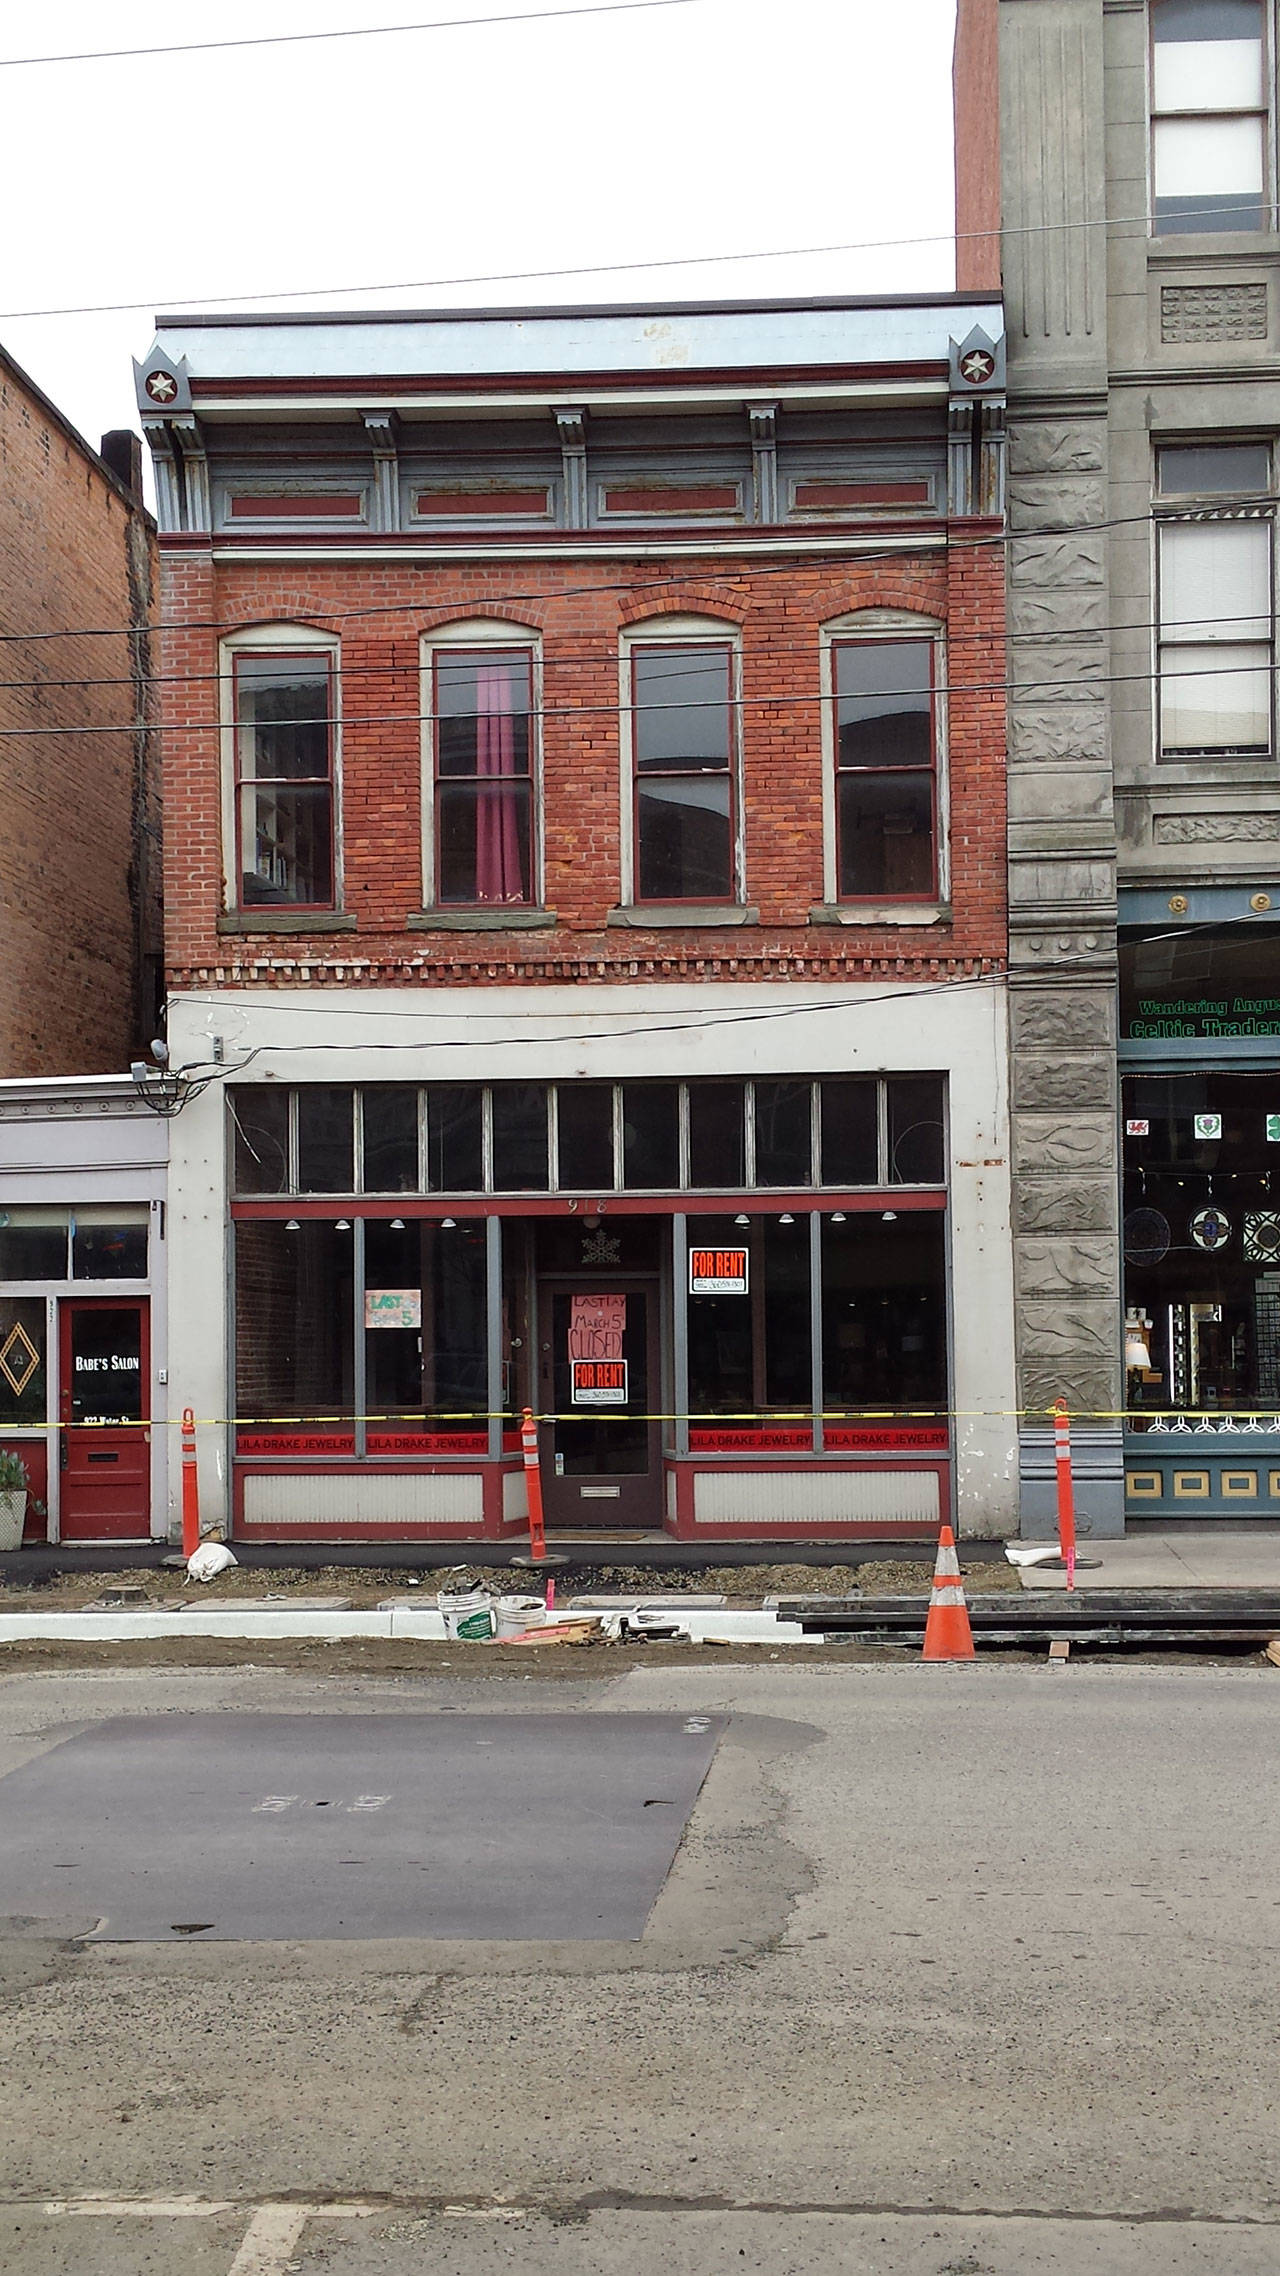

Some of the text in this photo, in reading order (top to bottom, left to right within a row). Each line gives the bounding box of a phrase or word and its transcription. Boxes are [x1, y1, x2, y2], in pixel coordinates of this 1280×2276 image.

[1138, 1000, 1228, 1016] Wandering
[1130, 1017, 1280, 1038] Celtic Trader
[568, 1199, 607, 1215] 918
[693, 1252, 745, 1277] FOR RENT
[370, 1295, 403, 1310] LAST
[574, 1295, 605, 1308] LAST
[401, 1310, 414, 1326] 5
[570, 1329, 621, 1360] CLOSED
[575, 1363, 624, 1388] FOR RENT
[237, 1439, 353, 1449] LILA DRAKE JEWELRY
[368, 1438, 485, 1449] LILA DRAKE JEWELRY
[692, 1435, 810, 1446] LILA DRAKE JEWELRY
[825, 1433, 946, 1445] LILA DRAKE JEWELRY
